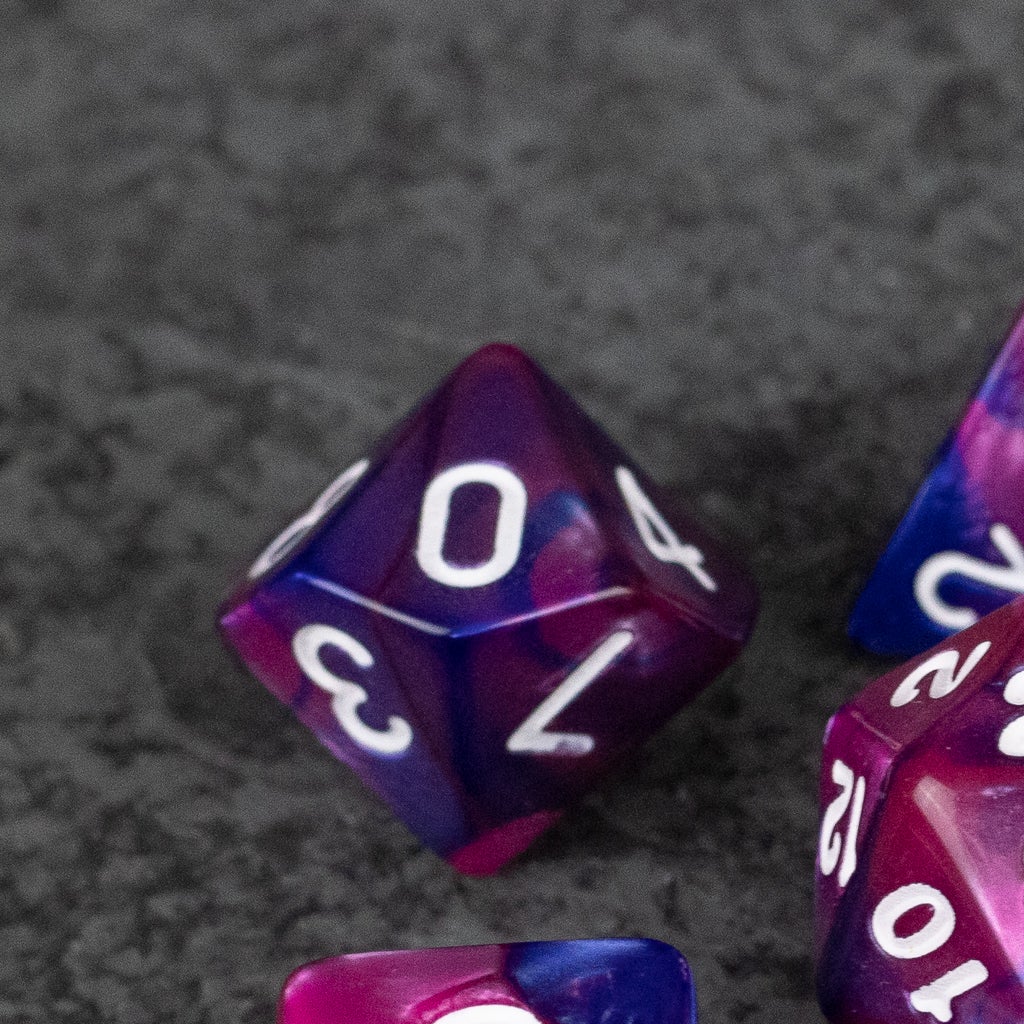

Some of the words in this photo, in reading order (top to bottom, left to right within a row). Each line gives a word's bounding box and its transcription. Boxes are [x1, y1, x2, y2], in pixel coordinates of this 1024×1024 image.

[416, 461, 528, 588] 0
[614, 466, 717, 592] 4
[292, 623, 413, 756] 3
[507, 630, 634, 755] 7
[890, 640, 992, 708] 2
[870, 882, 989, 1023] 10
